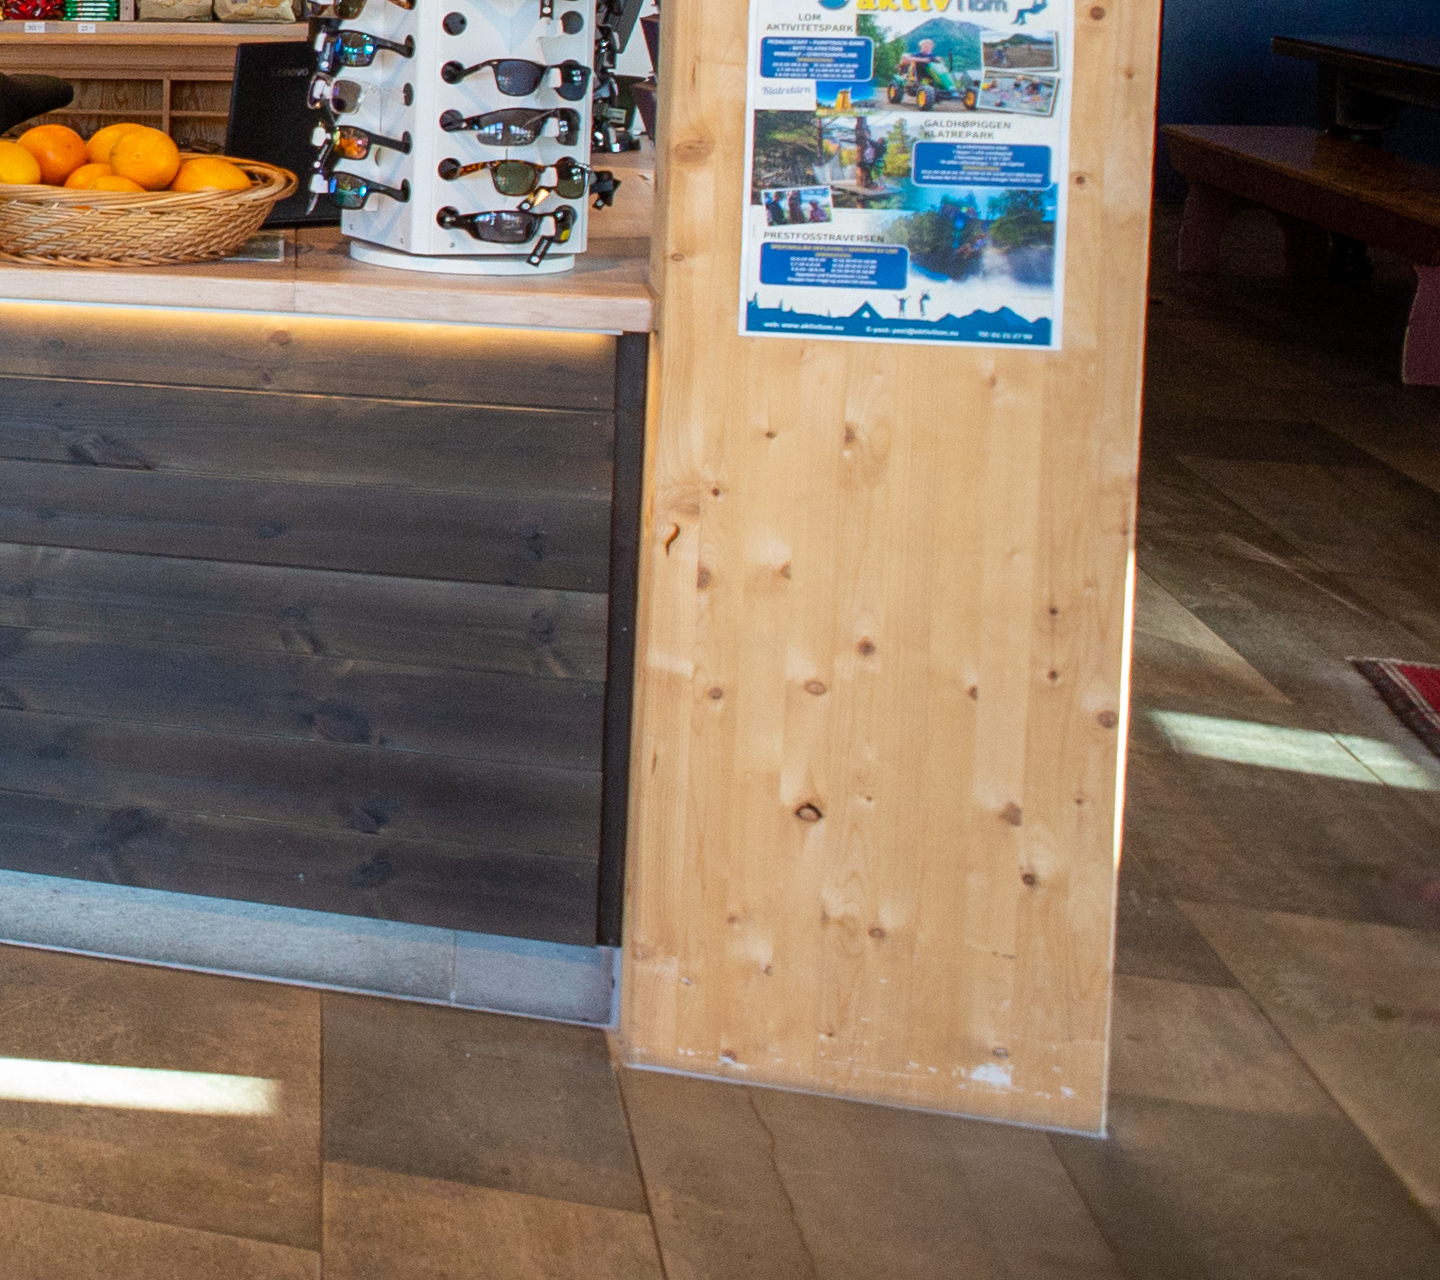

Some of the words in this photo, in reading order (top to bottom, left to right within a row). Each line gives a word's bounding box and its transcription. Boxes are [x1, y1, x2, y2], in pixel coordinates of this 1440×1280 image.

[798, 13, 822, 22] LOM
[766, 23, 855, 33] AKTIVITETSPARK
[923, 119, 1012, 130] GALDHØPIGGEN
[923, 130, 995, 140] KLATREPARK
[763, 231, 886, 243] PRESTFOSSTRAVERSEN
